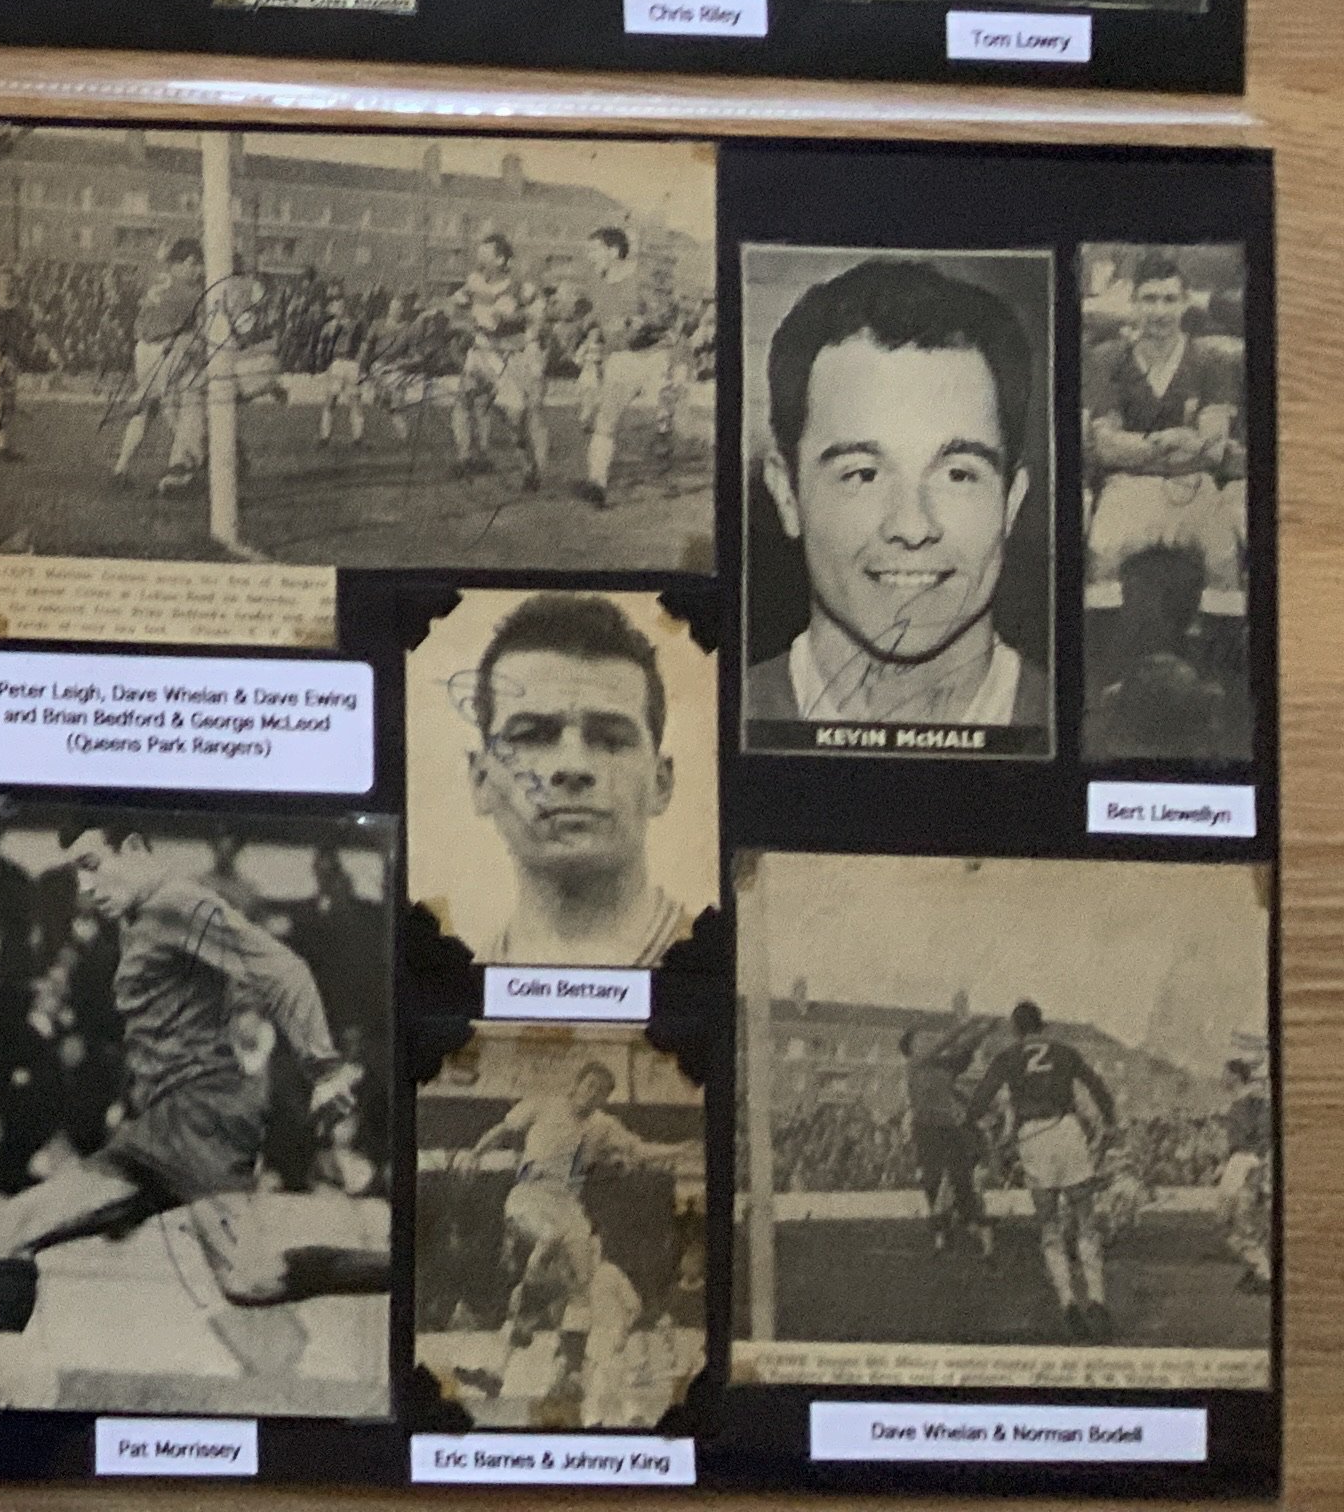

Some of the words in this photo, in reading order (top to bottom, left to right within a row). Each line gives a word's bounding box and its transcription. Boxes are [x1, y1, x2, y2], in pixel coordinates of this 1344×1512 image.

[649, 4, 694, 22] Chris
[698, 4, 742, 26] Riley
[971, 29, 1012, 48] Tom
[1015, 31, 1071, 53] Lowry
[52, 681, 106, 704] Leigh,
[111, 683, 158, 702] Dave
[164, 685, 229, 706] Whelan
[234, 686, 248, 706] &
[253, 687, 299, 706] Dave
[305, 689, 357, 711] Ewing
[4, 708, 38, 724] and
[42, 707, 88, 726] Brian
[93, 709, 166, 728] Bedford
[171, 711, 185, 729] &
[190, 711, 254, 732] George
[261, 713, 331, 732] McLeod
[66, 731, 142, 754] (Queens
[147, 735, 187, 754] Park
[192, 736, 272, 758] Rangers)
[816, 729, 887, 748] KEVIN
[896, 729, 987, 749] McHALE
[1106, 803, 1145, 821] Bert
[1150, 804, 1232, 826] Llewellyn
[506, 979, 551, 999] Colin
[556, 980, 629, 1003] Bettany
[871, 1422, 917, 1441] Dave
[923, 1422, 988, 1441] Whelan
[992, 1423, 1006, 1442] &
[1013, 1423, 1083, 1442] Norman
[1088, 1423, 1143, 1443] Bodell
[118, 1439, 149, 1458] Pat
[154, 1440, 242, 1462] Morrissey
[434, 1448, 468, 1469] Eric
[473, 1450, 536, 1469] Barnes
[541, 1450, 555, 1470] &
[561, 1451, 625, 1473] Johnny
[630, 1451, 670, 1474] King
